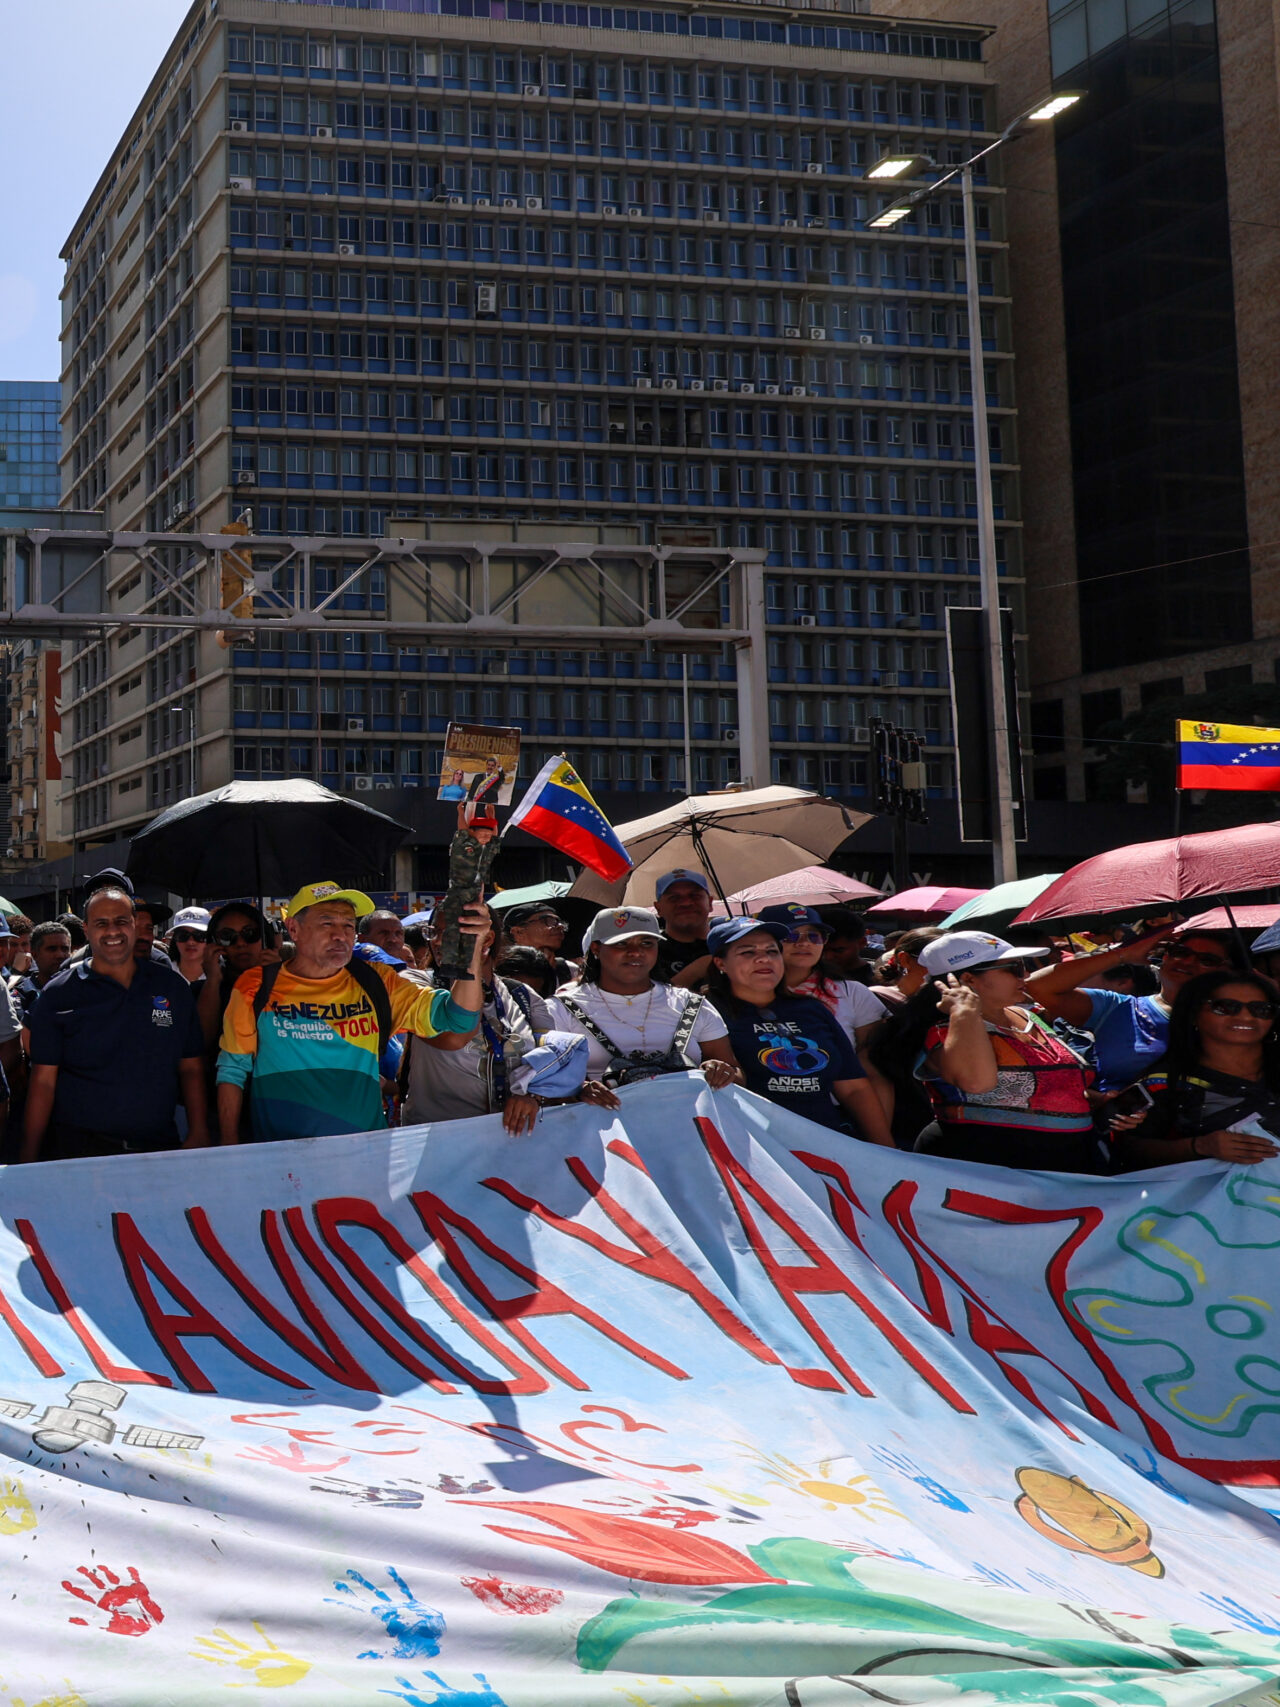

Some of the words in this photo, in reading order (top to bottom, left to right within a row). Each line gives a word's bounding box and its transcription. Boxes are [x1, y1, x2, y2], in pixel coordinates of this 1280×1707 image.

[292, 1030, 334, 1041] nuestro
[767, 1085, 821, 1093] ESPACIO
[15, 1211, 318, 1394] LA
[185, 1189, 694, 1396] VIDA
